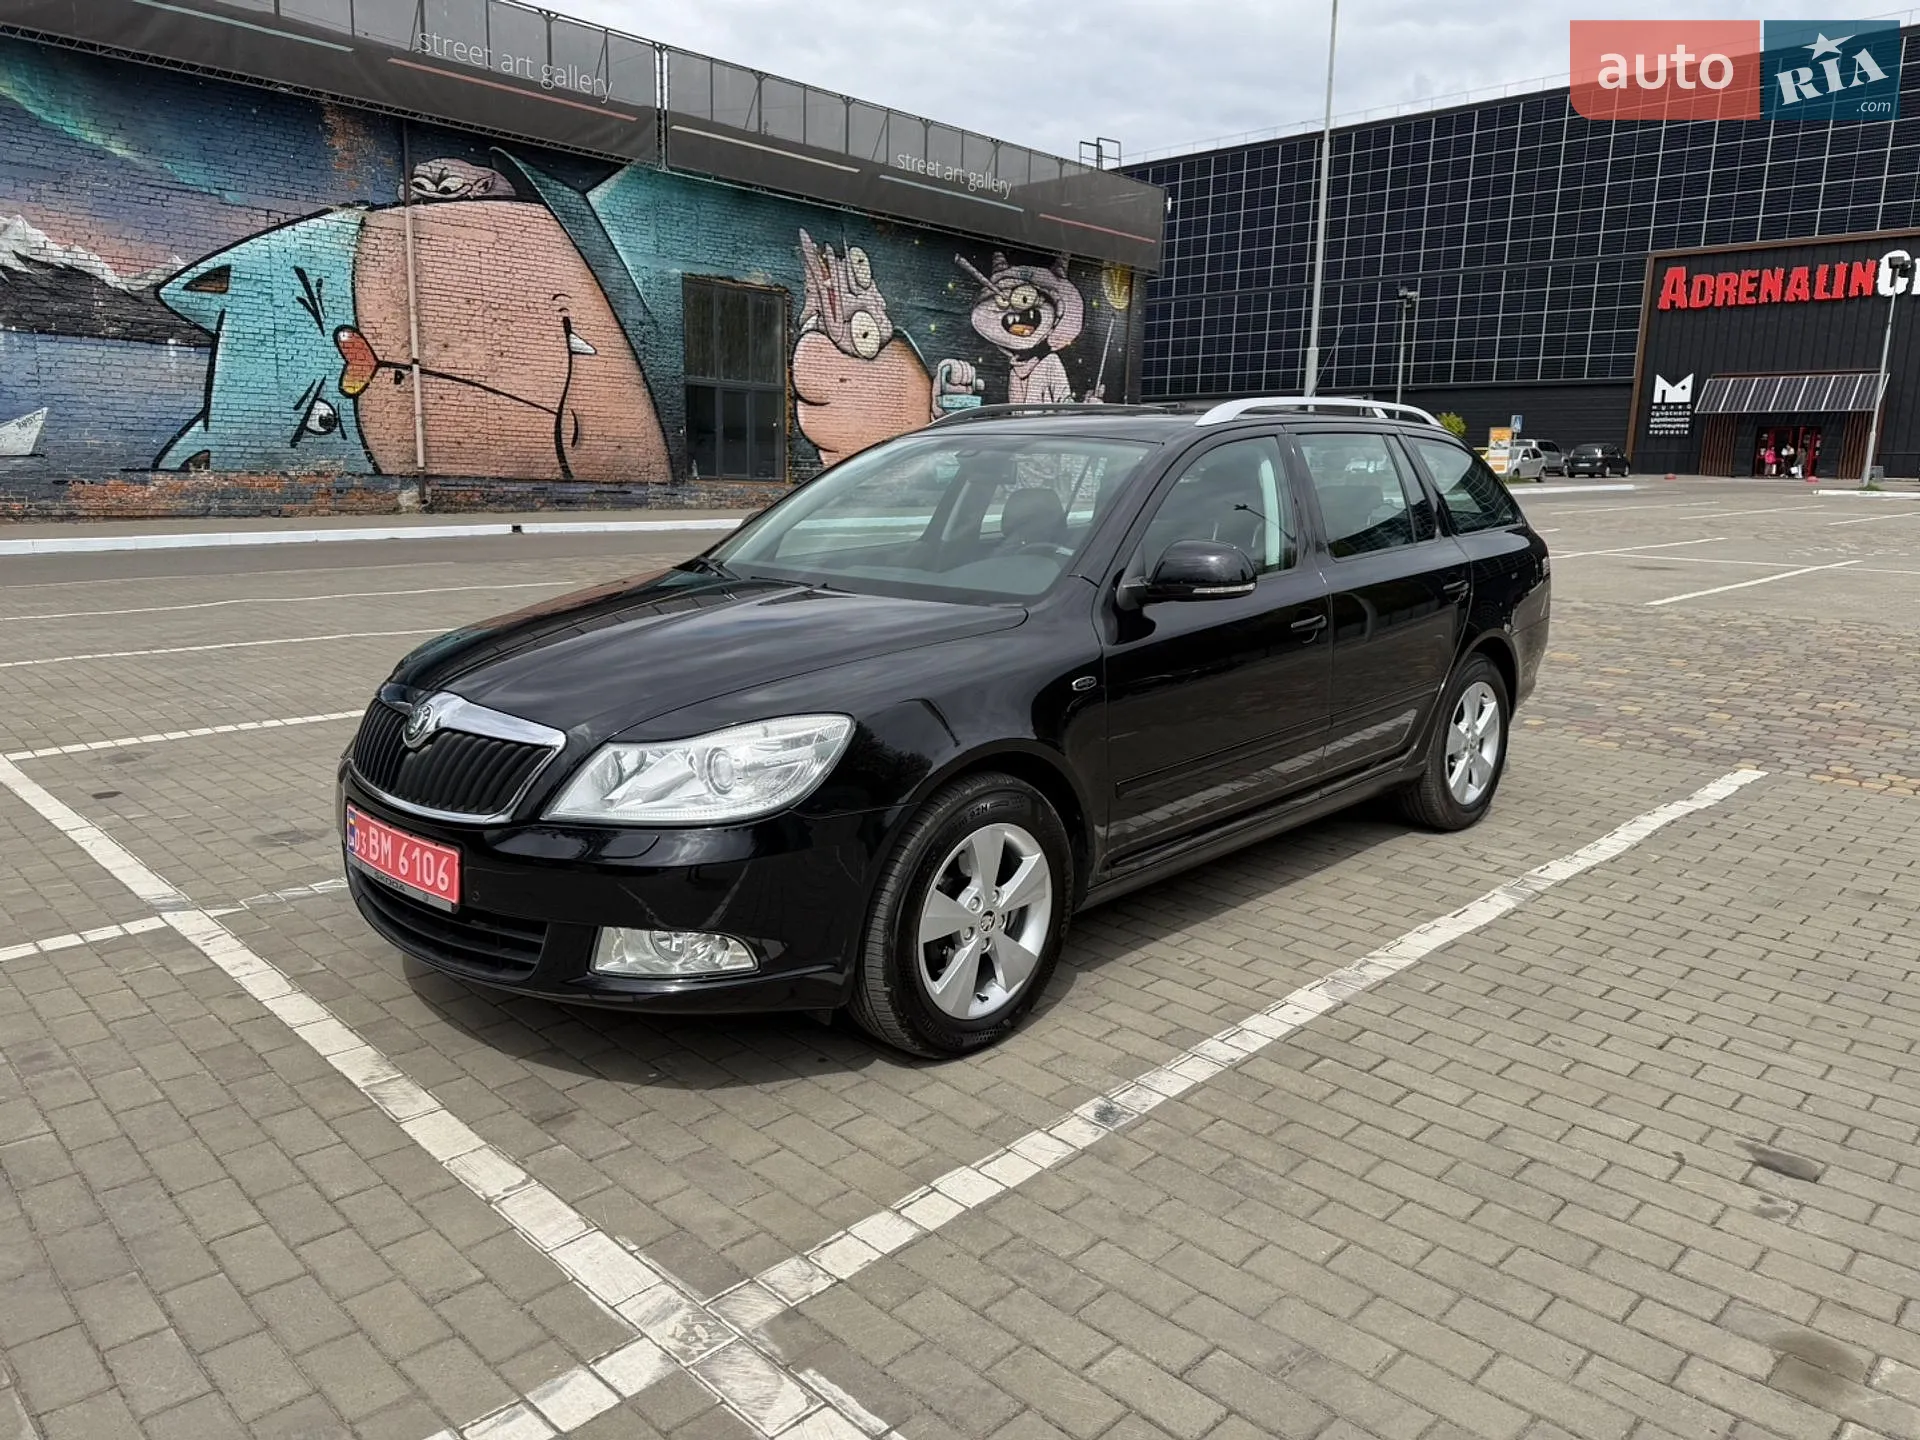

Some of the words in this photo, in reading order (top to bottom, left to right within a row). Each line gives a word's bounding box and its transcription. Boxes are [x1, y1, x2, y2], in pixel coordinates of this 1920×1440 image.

[417, 33, 492, 69] street
[500, 53, 534, 78] art
[540, 64, 613, 104] gallery
[897, 153, 941, 178] street
[943, 165, 965, 184] art
[968, 171, 1012, 200] gallery
[369, 826, 392, 869] BM
[398, 842, 449, 892] 6106
